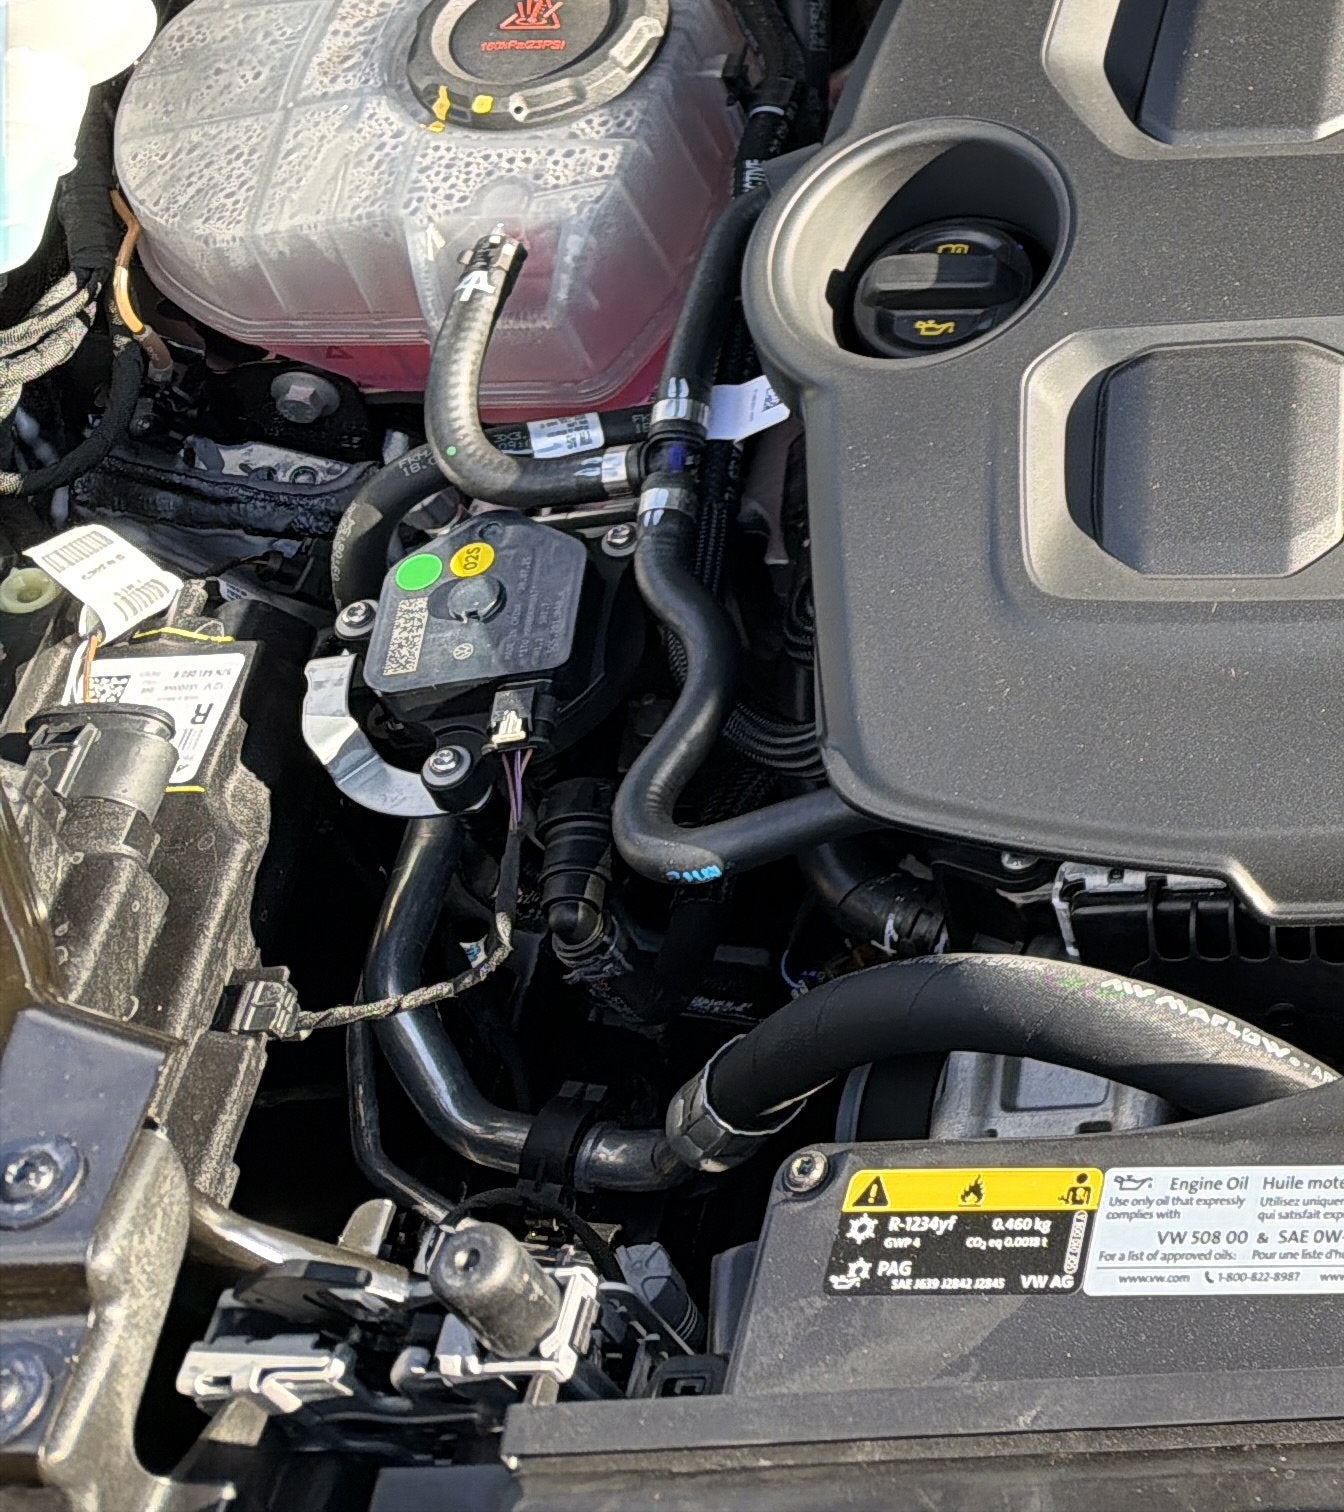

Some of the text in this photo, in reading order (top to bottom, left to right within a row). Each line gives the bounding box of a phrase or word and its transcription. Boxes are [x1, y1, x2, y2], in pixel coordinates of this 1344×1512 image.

[1169, 1176, 1249, 1194] Engine Oil
[1263, 1176, 1304, 1190] Huile
[1109, 1195, 1246, 1209] Use only oil that expressly
[1260, 1196, 1299, 1207] Utilisez
[1106, 1209, 1181, 1222] complies with
[1257, 1209, 1276, 1223] qui
[1278, 1208, 1320, 1220] satisfait
[888, 1215, 959, 1236] R-1234yf
[992, 1217, 1051, 1235] 0.460 kg
[883, 1237, 912, 1248] GWP
[1157, 1231, 1188, 1245] VW
[1191, 1231, 1221, 1245] 508
[1225, 1230, 1249, 1245] 00
[1257, 1233, 1269, 1244] &
[1278, 1229, 1310, 1244] SAE
[1099, 1249, 1238, 1264] For a list of approved oils:
[1252, 1249, 1277, 1261] Pour
[1279, 1250, 1299, 1260] une
[1301, 1248, 1323, 1260] liste
[876, 1261, 913, 1277] PAG
[1021, 1275, 1075, 1289] VW AG
[1119, 1274, 1191, 1284] www.vw.com
